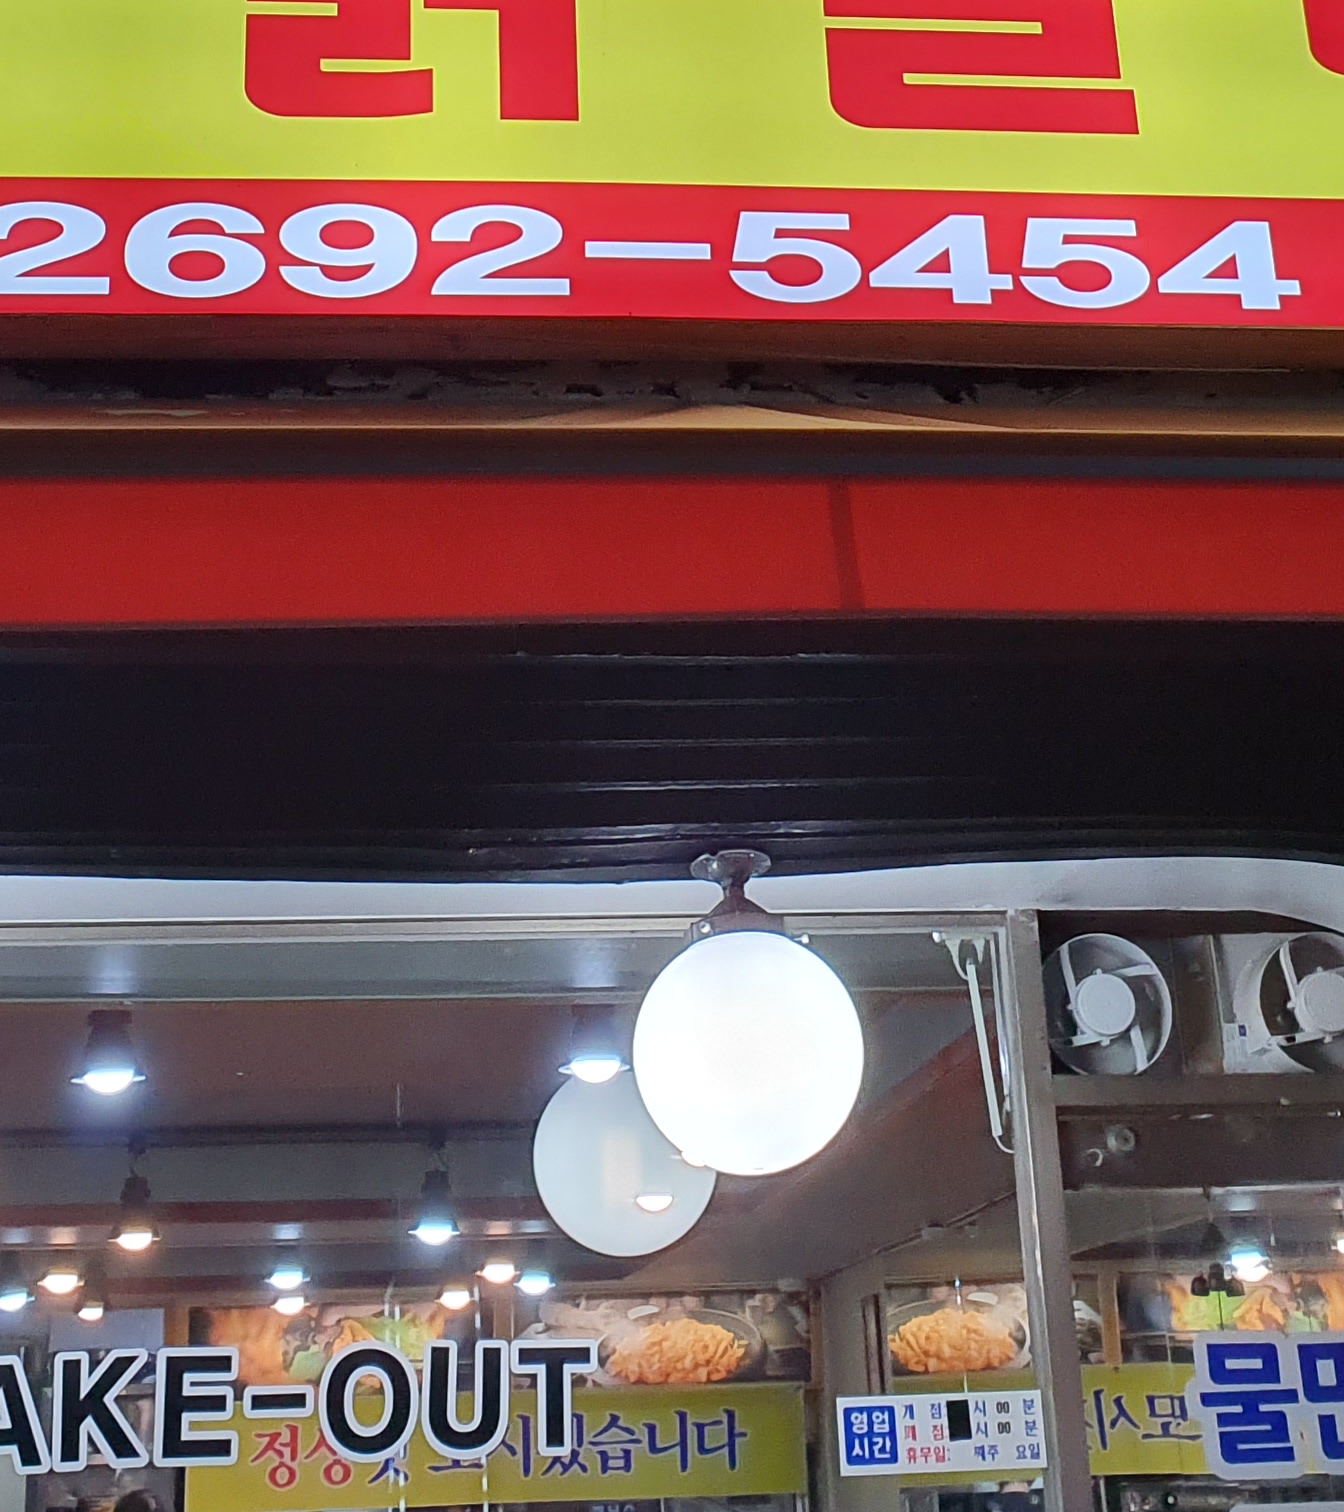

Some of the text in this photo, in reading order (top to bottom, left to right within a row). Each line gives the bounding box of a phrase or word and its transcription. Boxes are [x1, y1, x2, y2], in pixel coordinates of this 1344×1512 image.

[973, 1399, 987, 1417] 시
[996, 1401, 1010, 1414] 00
[1023, 1398, 1035, 1415] 분
[851, 1410, 890, 1434] 영업
[975, 1421, 989, 1438] 시
[997, 1421, 1011, 1434] 00
[1024, 1420, 1038, 1437] 분
[852, 1437, 891, 1459] 시간
[1015, 1442, 1041, 1460] 요일
